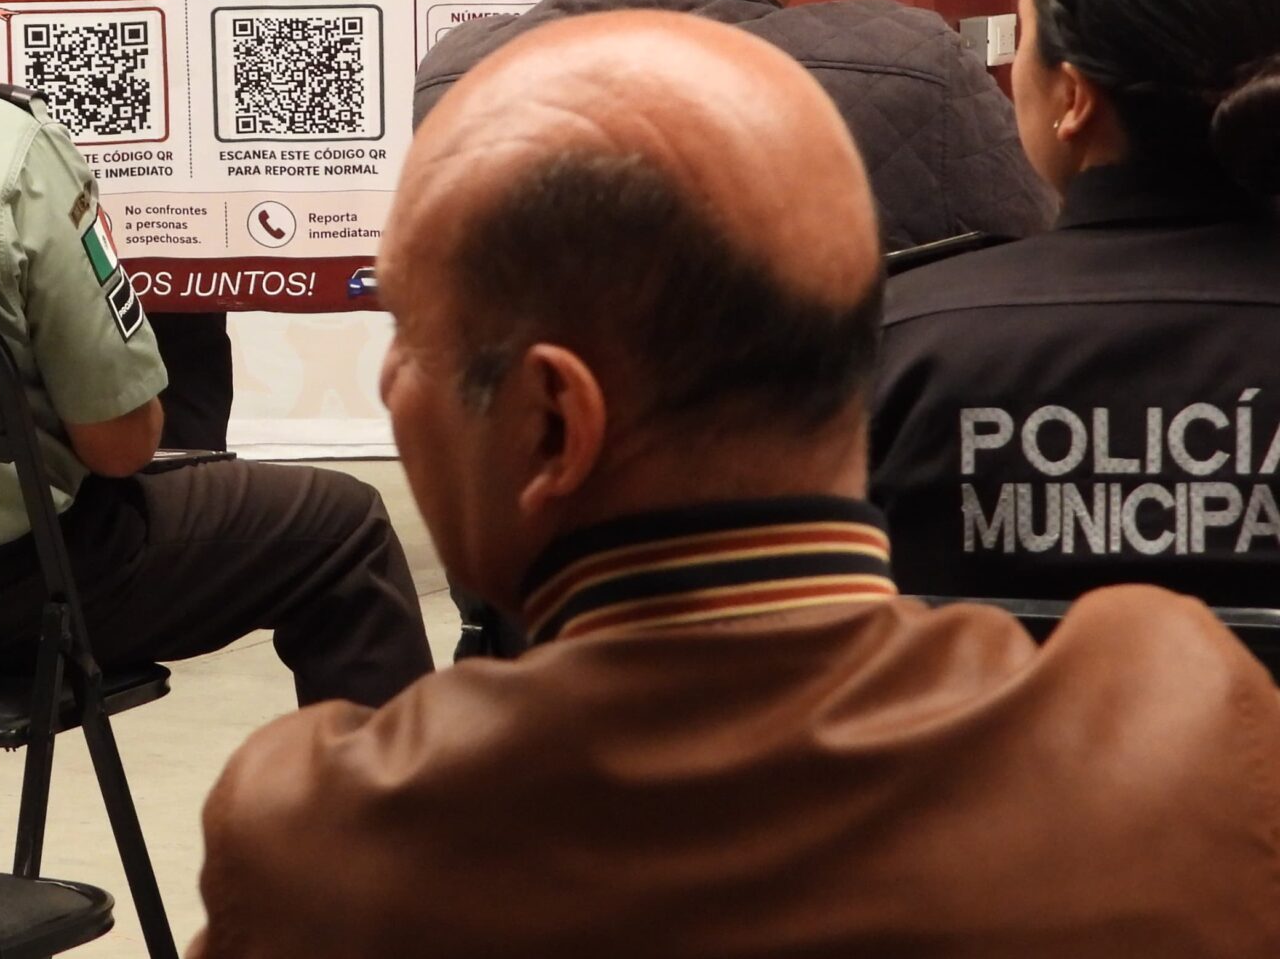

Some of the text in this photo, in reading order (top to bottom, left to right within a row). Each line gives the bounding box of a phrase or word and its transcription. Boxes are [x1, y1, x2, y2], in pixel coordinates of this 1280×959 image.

[103, 150, 153, 163] CÓDIGO
[156, 151, 173, 162] QR
[219, 148, 387, 161] ESCANEA ESTE CÓDIGO QR
[105, 166, 173, 179] INMEDIATO
[227, 164, 379, 176] PARA REPORTE NORMAL
[125, 205, 207, 216] No confrontes
[308, 213, 358, 225] Reporta
[125, 220, 188, 232] a personas
[308, 227, 381, 239] inmediatam
[125, 234, 202, 246] sospechosas.
[129, 270, 316, 298] OS JUNTOS!
[961, 482, 1280, 555] MUNICIPA
